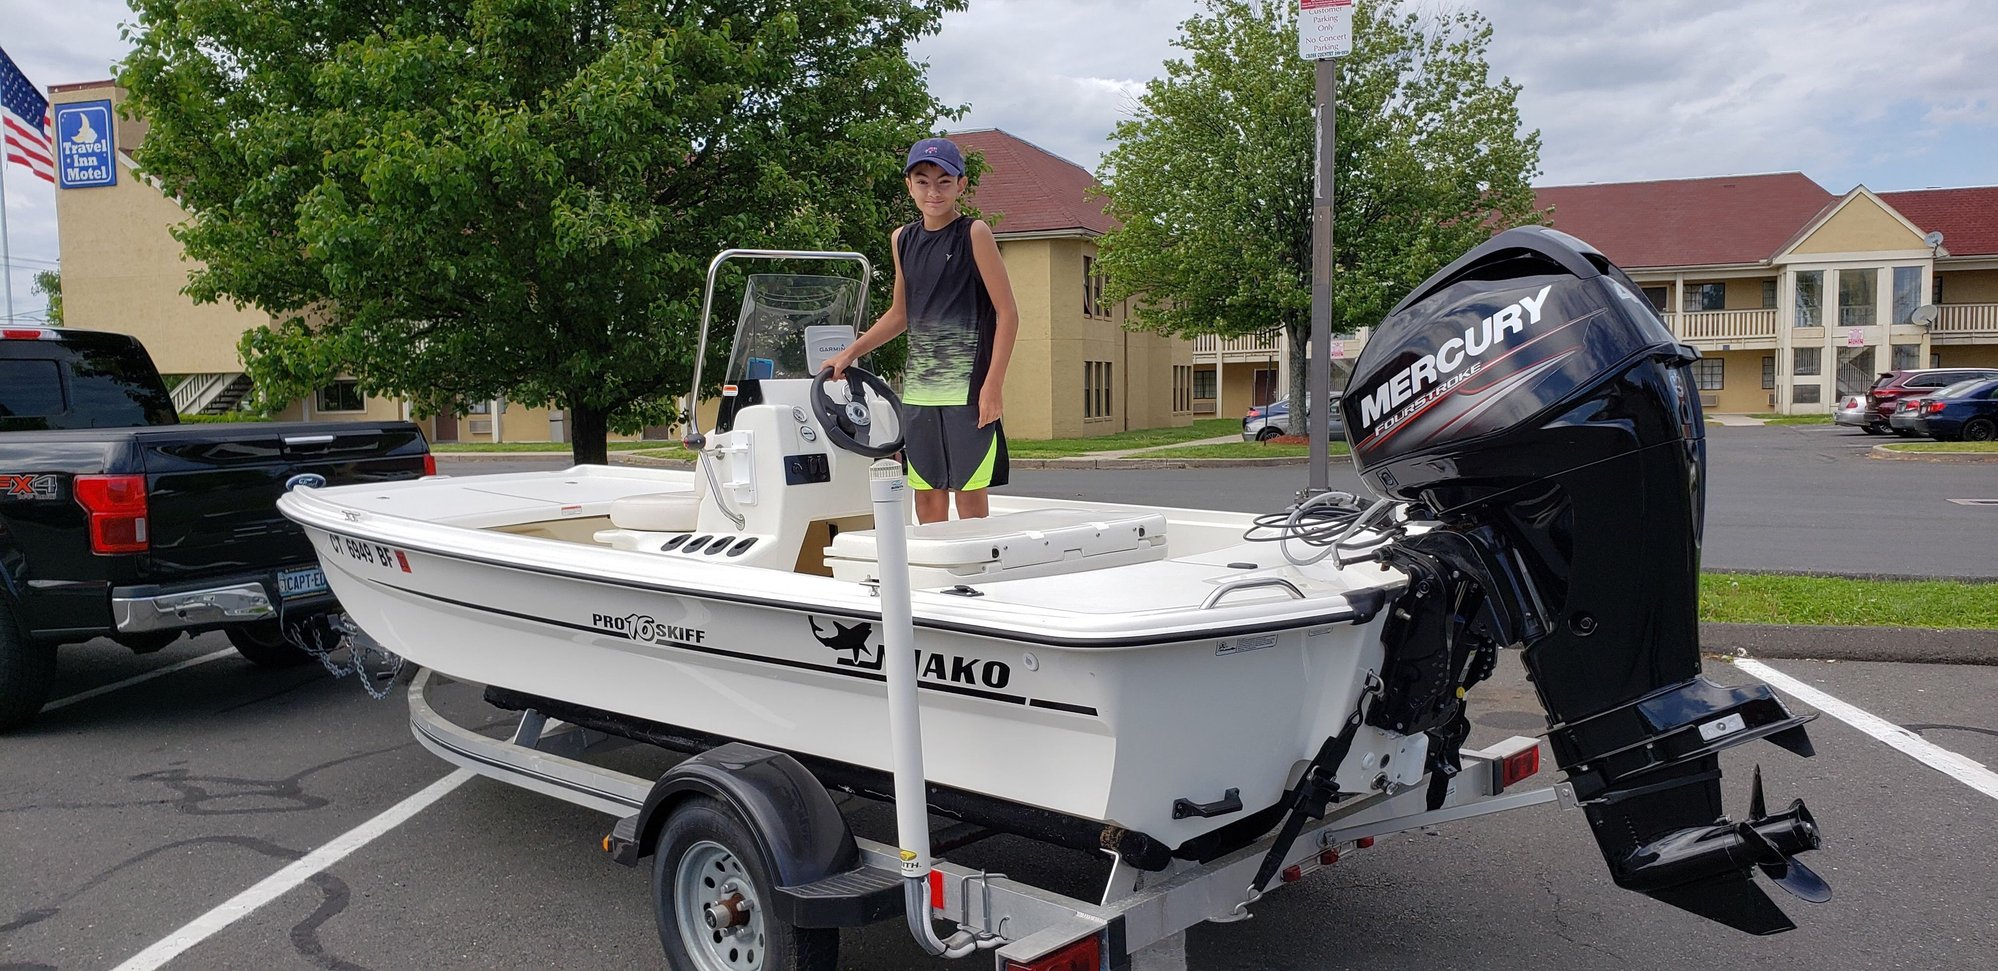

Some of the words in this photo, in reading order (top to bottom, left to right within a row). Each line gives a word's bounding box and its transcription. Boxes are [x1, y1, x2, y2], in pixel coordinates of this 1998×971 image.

[1309, 7, 1342, 15] Customer
[1317, 24, 1333, 32] Only
[1319, 34, 1347, 42] Concert
[63, 139, 107, 154] Travel
[73, 154, 98, 167] Inn
[67, 166, 107, 181] Motel
[1361, 285, 1552, 429] MERCURY
[1375, 361, 1483, 437] FOURSTROKE
[329, 533, 344, 555] CT
[346, 538, 374, 564] 6949
[375, 546, 393, 568] BF
[592, 613, 625, 630] PRO
[625, 613, 655, 642] 16
[656, 624, 705, 643] SKIFF
